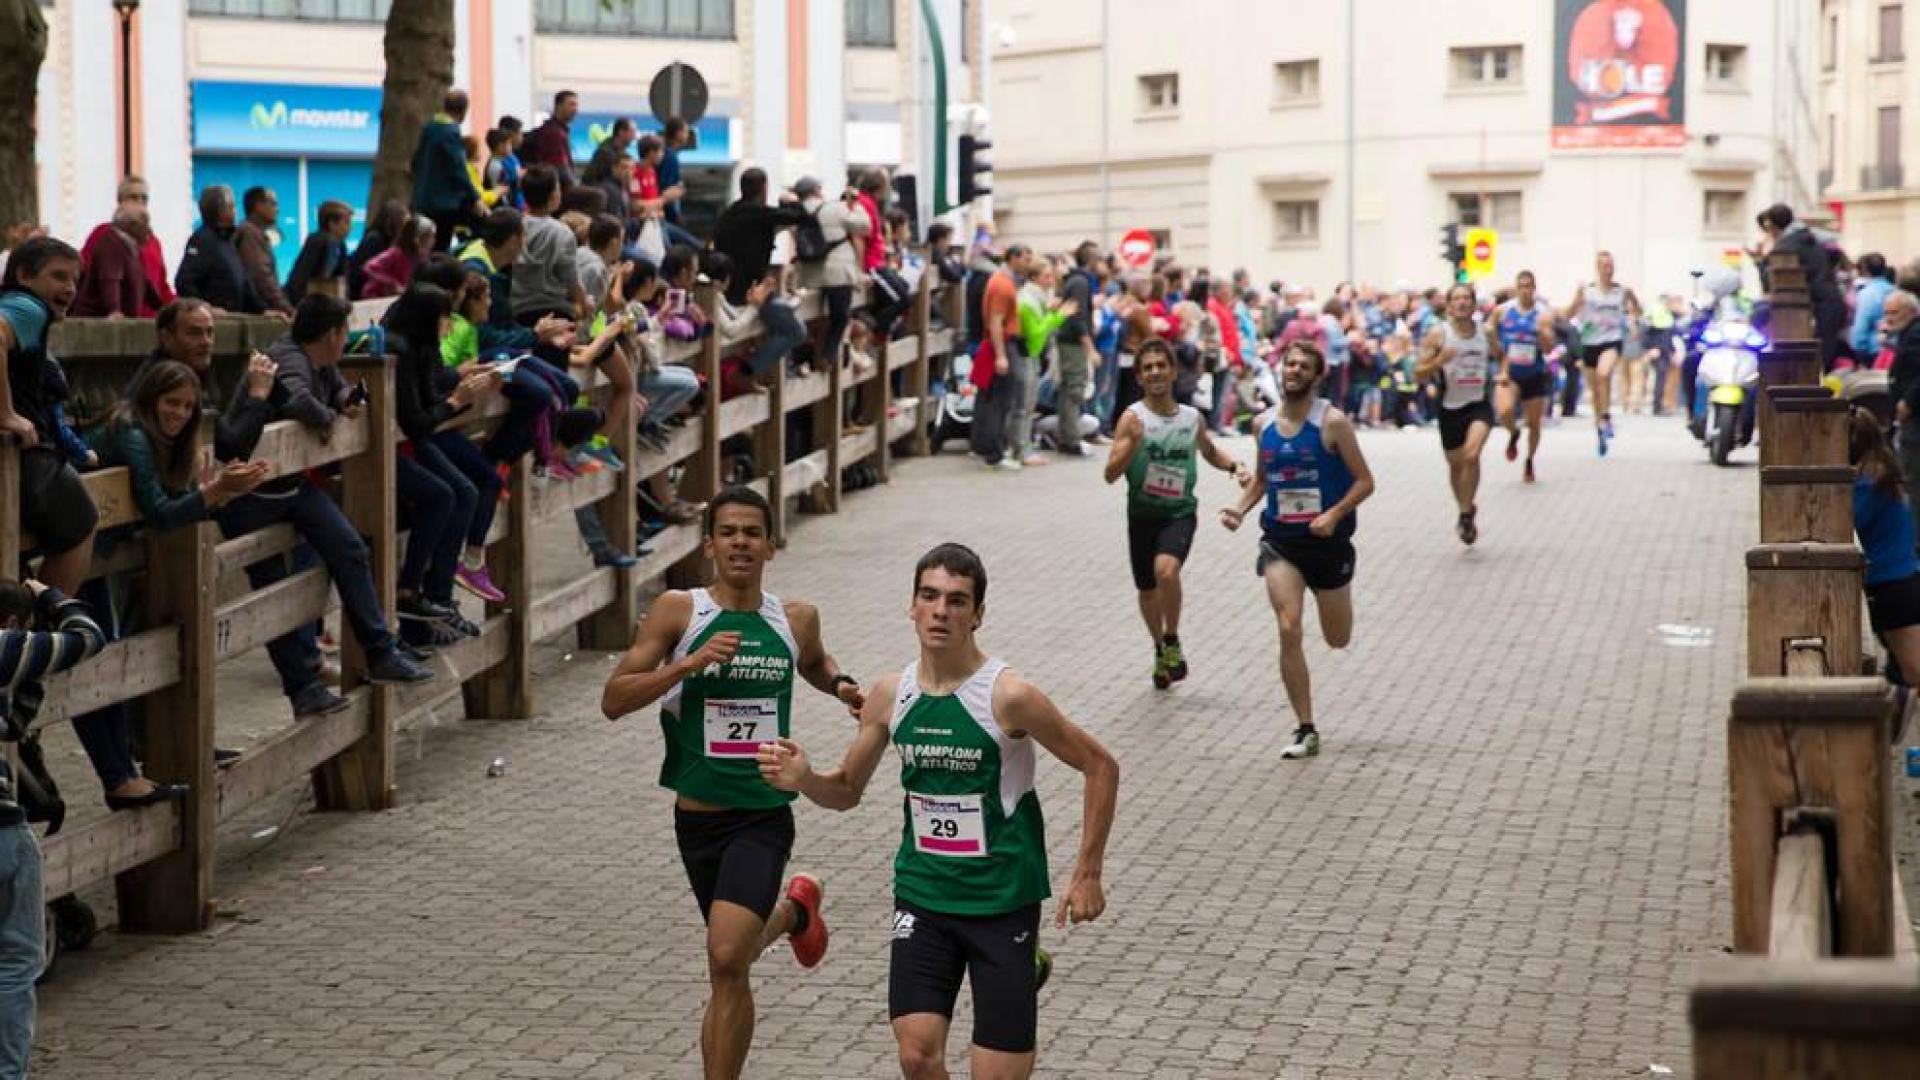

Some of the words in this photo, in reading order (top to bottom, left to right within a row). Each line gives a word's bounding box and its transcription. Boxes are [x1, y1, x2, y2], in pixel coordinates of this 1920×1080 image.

[290, 108, 369, 129] movistar
[727, 722, 757, 740] 27
[914, 744, 982, 761] PAMPLONA
[930, 818, 959, 838] 29
